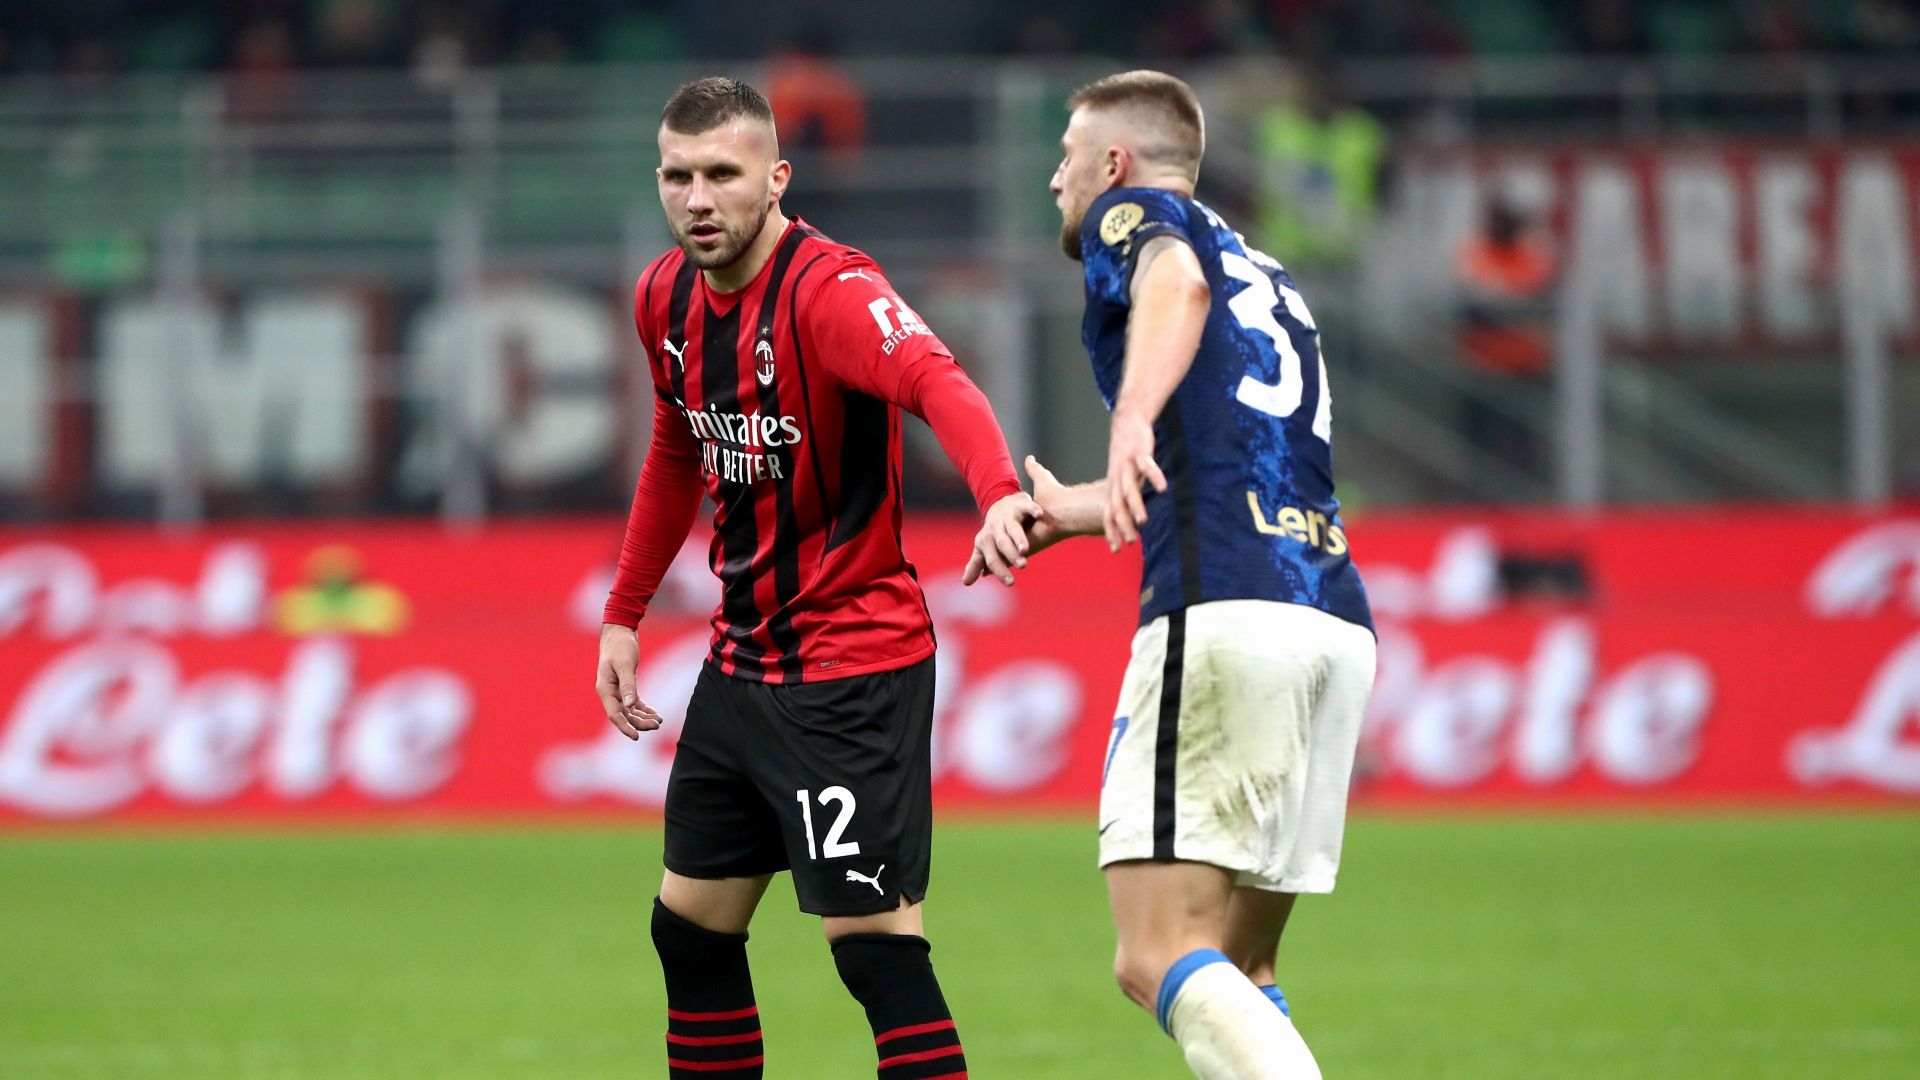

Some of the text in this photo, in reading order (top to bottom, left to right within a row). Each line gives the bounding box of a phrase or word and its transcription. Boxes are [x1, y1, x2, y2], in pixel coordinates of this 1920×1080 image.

[881, 323, 934, 355] BitME
[1220, 250, 1332, 443] 37
[722, 447, 784, 485] BETTER
[796, 785, 861, 860] 12
